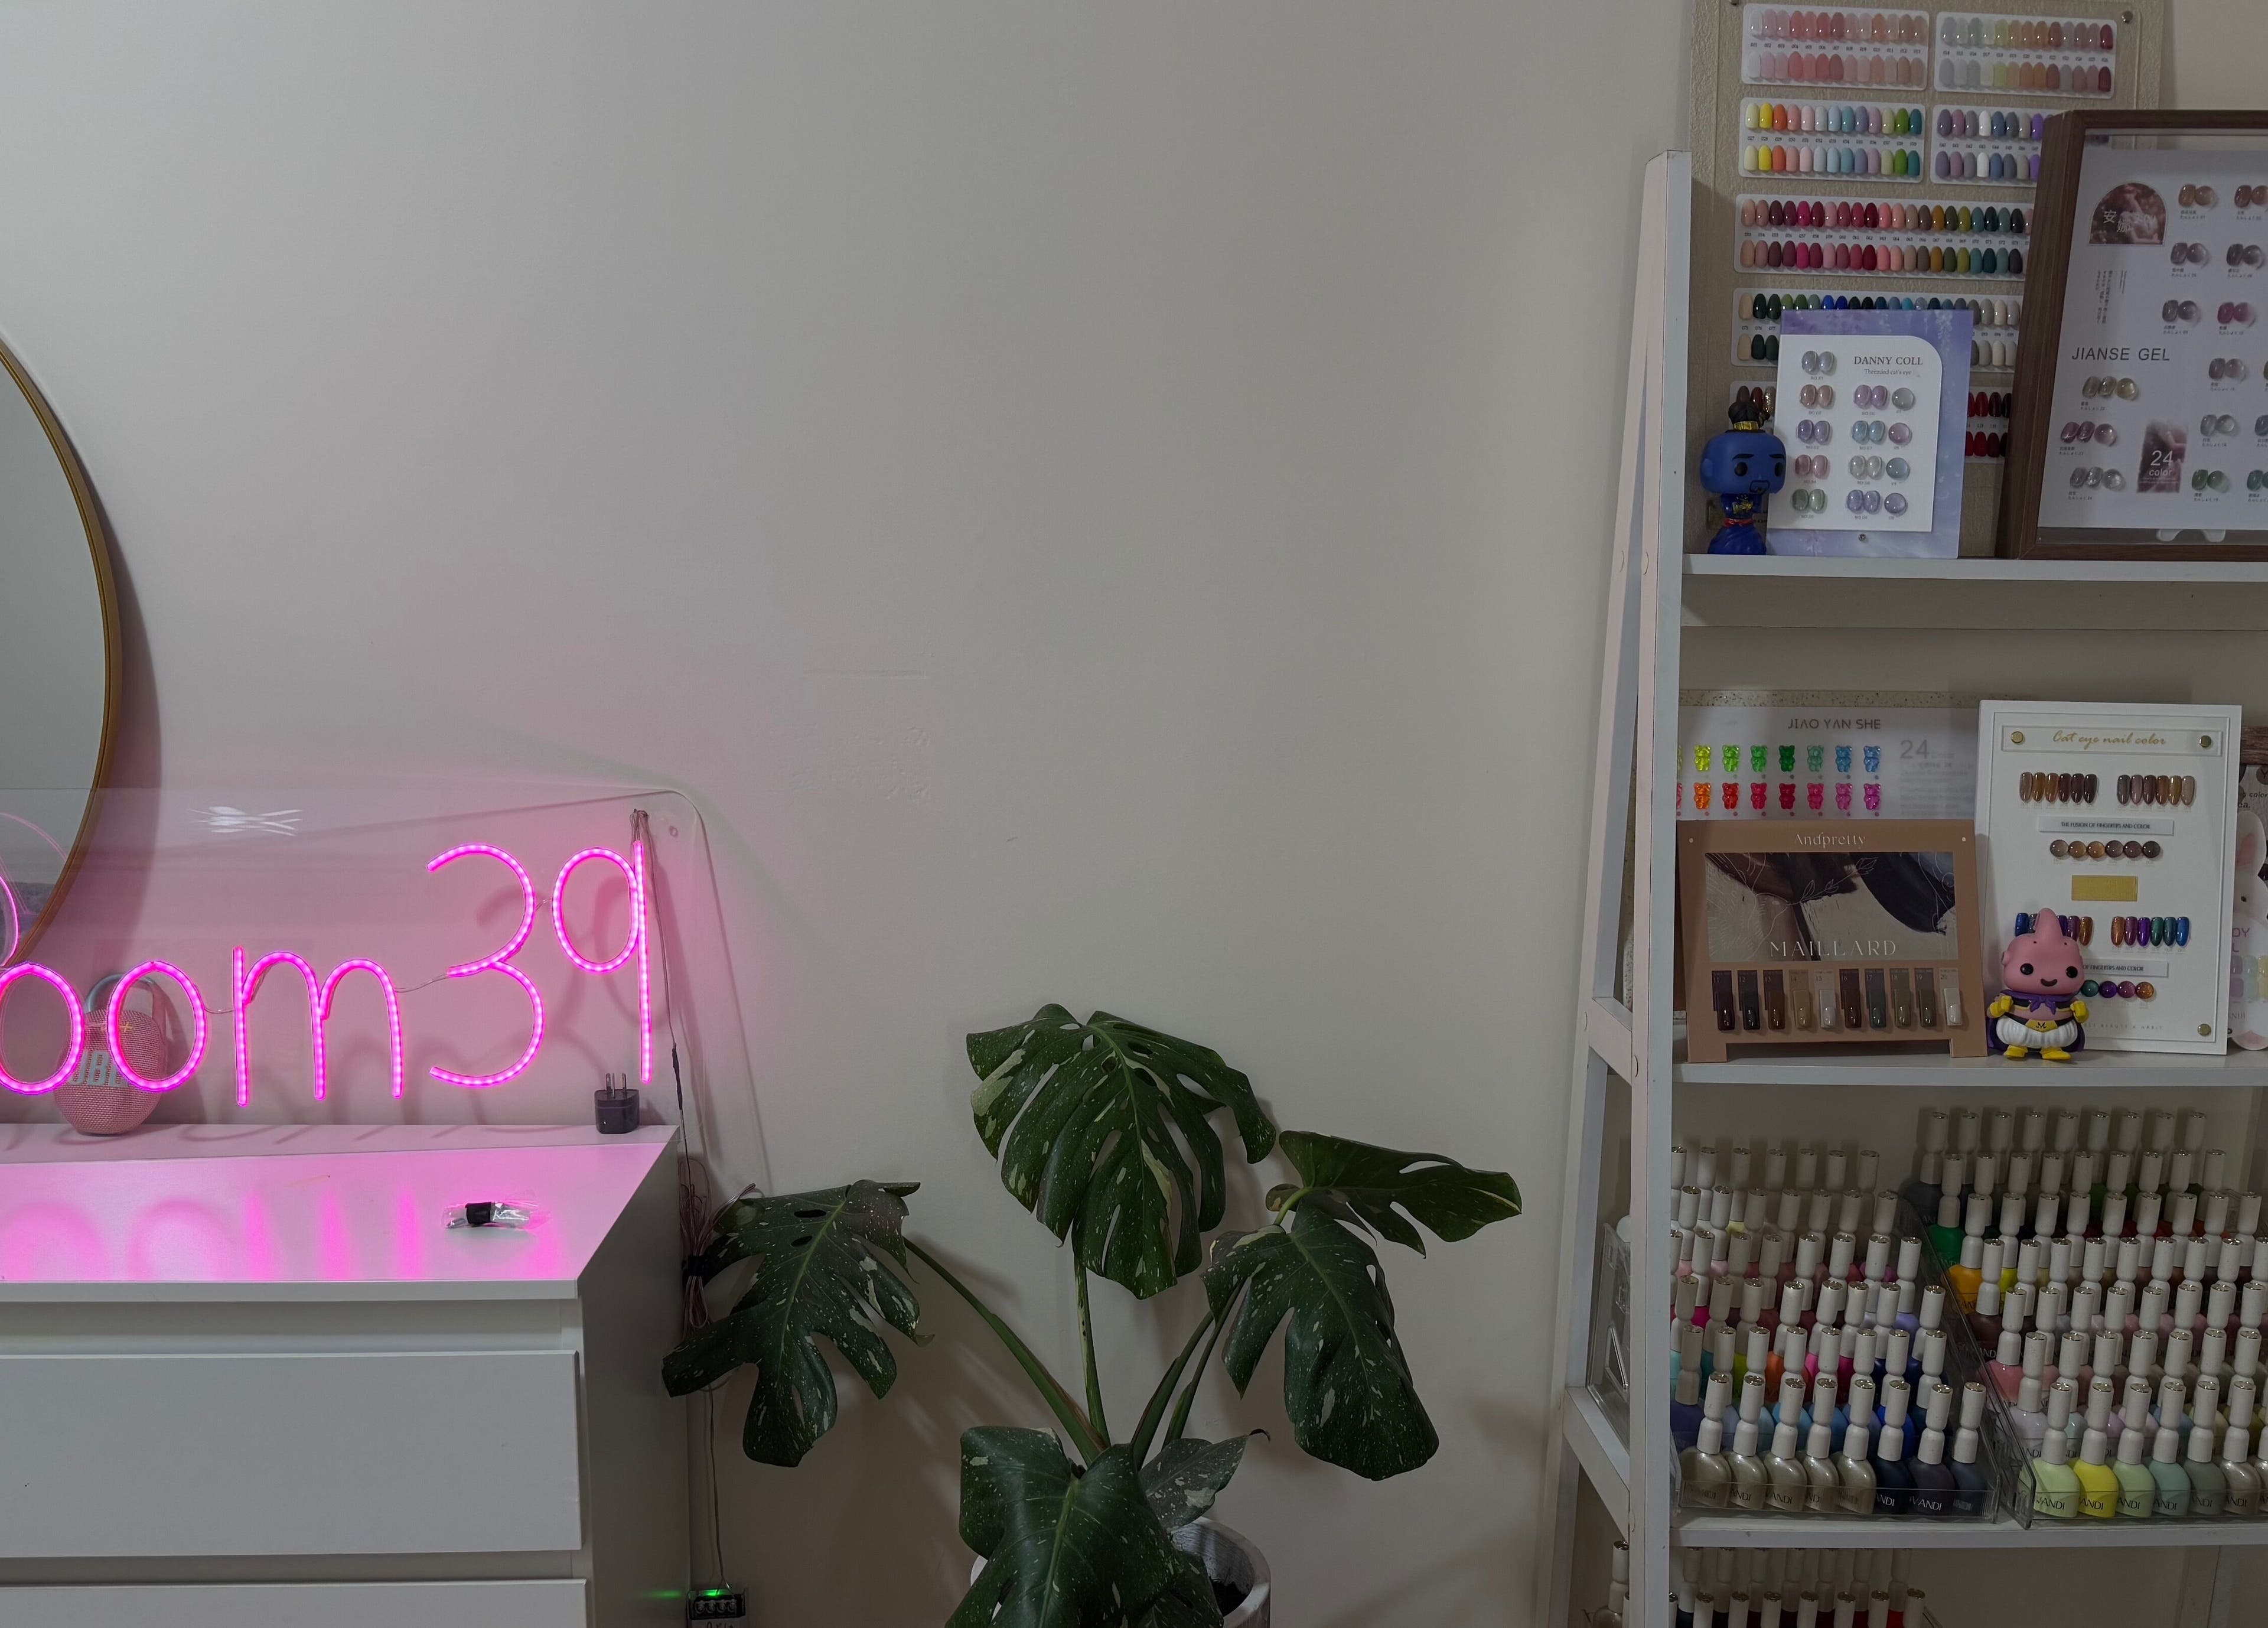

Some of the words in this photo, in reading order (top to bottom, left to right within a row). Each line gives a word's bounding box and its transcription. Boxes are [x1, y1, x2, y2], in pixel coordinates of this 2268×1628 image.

[1854, 356, 1892, 364] DANNY
[1896, 357, 1923, 365] COLL
[2071, 347, 2130, 360] JIANSE
[2138, 347, 2170, 361] GEL
[2150, 450, 2173, 466] 24
[2149, 468, 2173, 476] color
[1788, 718, 1819, 729] JIAO
[1823, 719, 1851, 729] YAN
[1856, 719, 1881, 730] SHE
[2052, 730, 2077, 743] Cat
[2078, 736, 2100, 750] eye
[2103, 732, 2134, 744] nail
[2135, 732, 2166, 744] color
[1899, 739, 1930, 759] 24
[1794, 832, 1866, 849] Andpretty
[1770, 940, 1896, 957] MAILLARD
